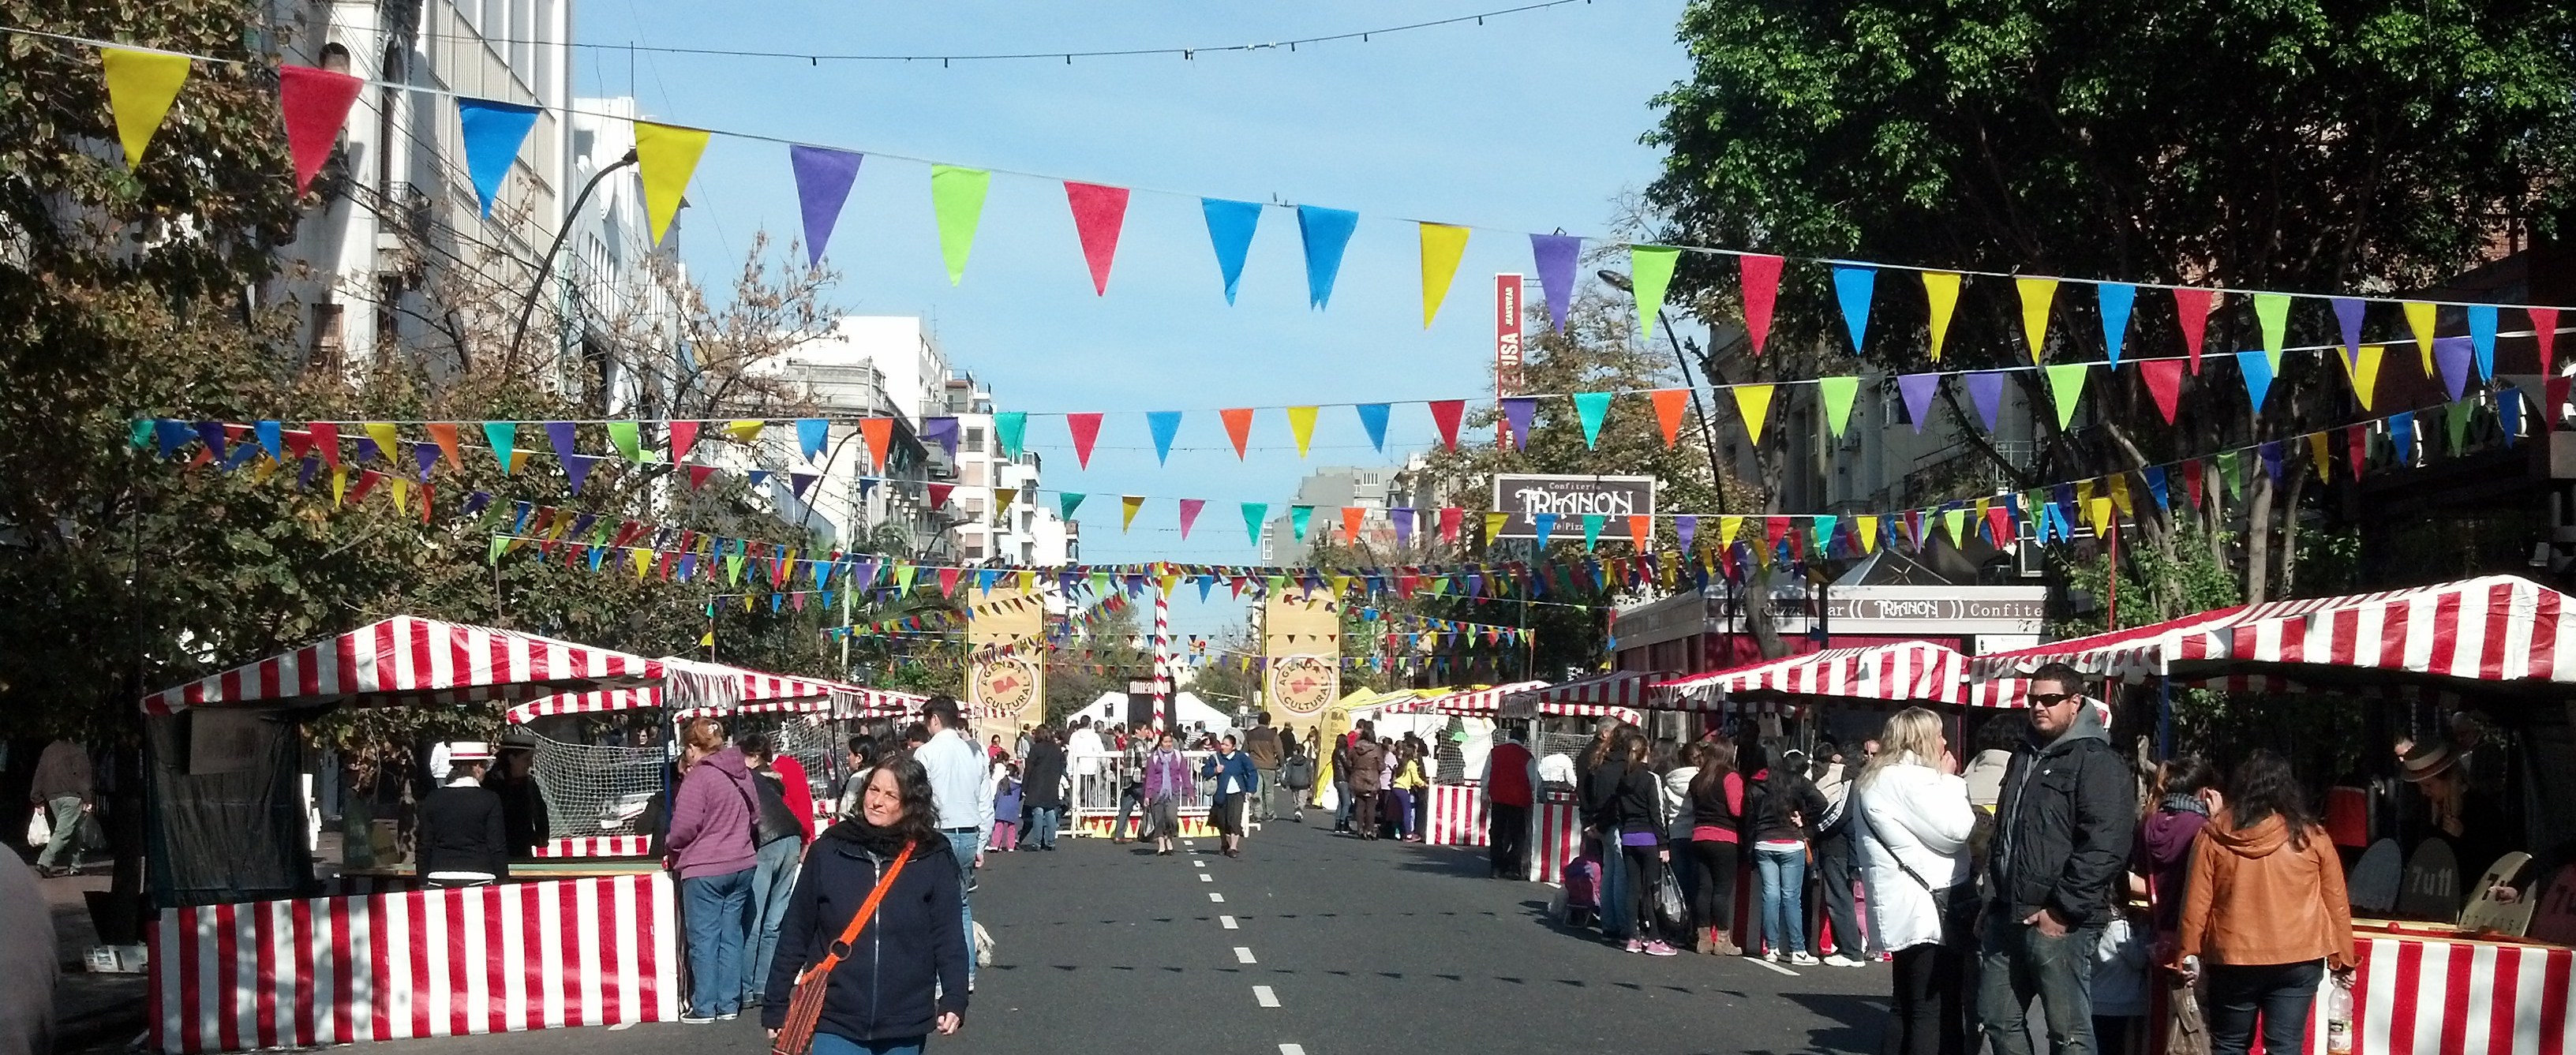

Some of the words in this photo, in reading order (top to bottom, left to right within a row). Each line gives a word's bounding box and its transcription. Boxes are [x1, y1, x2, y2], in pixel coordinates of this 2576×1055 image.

[1515, 486, 1633, 525] TRIANON
[1565, 522, 1585, 531] Pizz
[1874, 600, 1939, 619] TRIANON
[986, 680, 1031, 710] CULTURAL
[1284, 681, 1328, 710] CULTURAL
